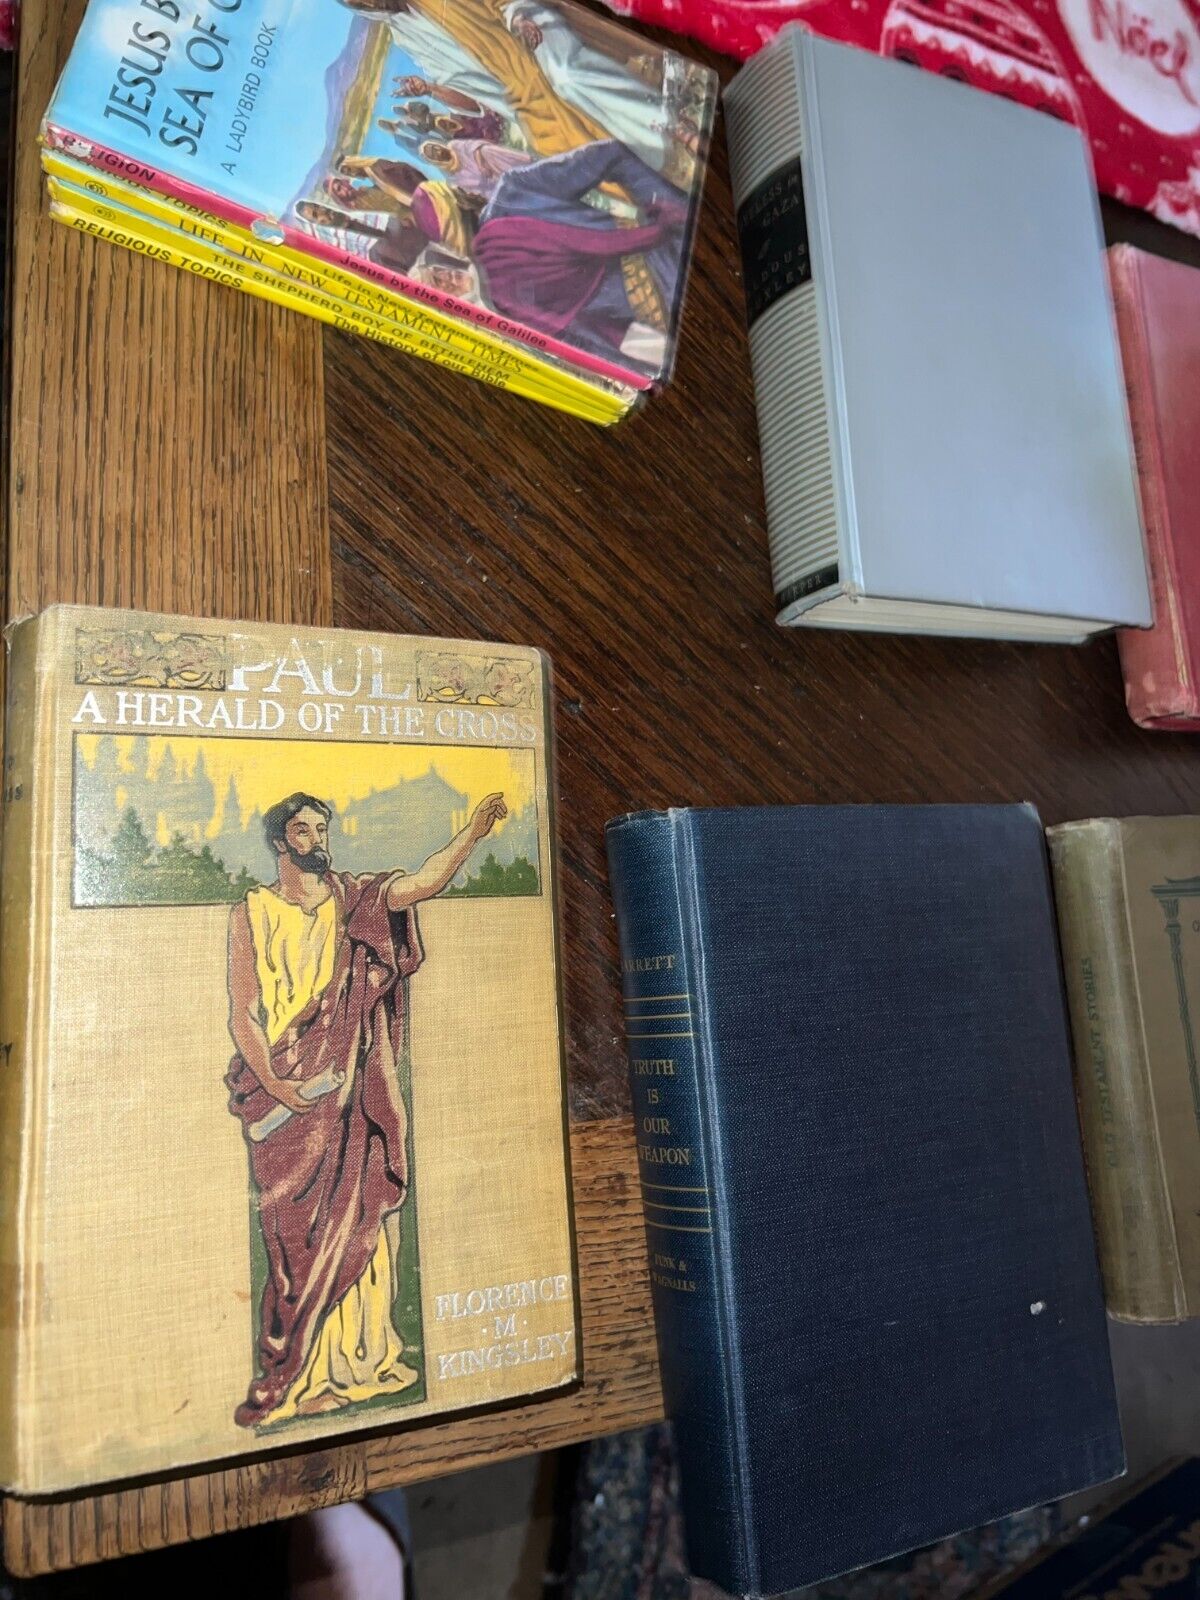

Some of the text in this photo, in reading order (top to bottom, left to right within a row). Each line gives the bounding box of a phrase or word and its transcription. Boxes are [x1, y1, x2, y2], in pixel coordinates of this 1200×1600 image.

[185, 14, 229, 72] OF
[104, 21, 171, 138] JESUS
[220, 22, 277, 175] A LADYBIRD BOOK
[159, 88, 214, 156] SEA
[73, 218, 244, 289] RELIGIOUS TOPICS
[179, 217, 522, 372] LIFE IN NEW TESTAMENT TIMES
[212, 253, 510, 380] THE SHEPHERD BOY OF BETHLEHEM
[323, 268, 352, 285] Life
[358, 284, 371, 296] in
[377, 293, 411, 313] New
[340, 256, 547, 347] Jesus by the Sea of Galilee
[334, 314, 507, 388] The History of our Bible
[228, 633, 412, 700] PAUL
[71, 690, 537, 742] A HERALD OF THE CROSS
[1081, 957, 1099, 1021] STORIES
[633, 1059, 675, 1075] TRUTH
[647, 1088, 659, 1104] IS
[643, 1117, 671, 1135] OUR
[434, 1274, 568, 1321] FLORENCE
[438, 1331, 572, 1379] KINGSLEY
